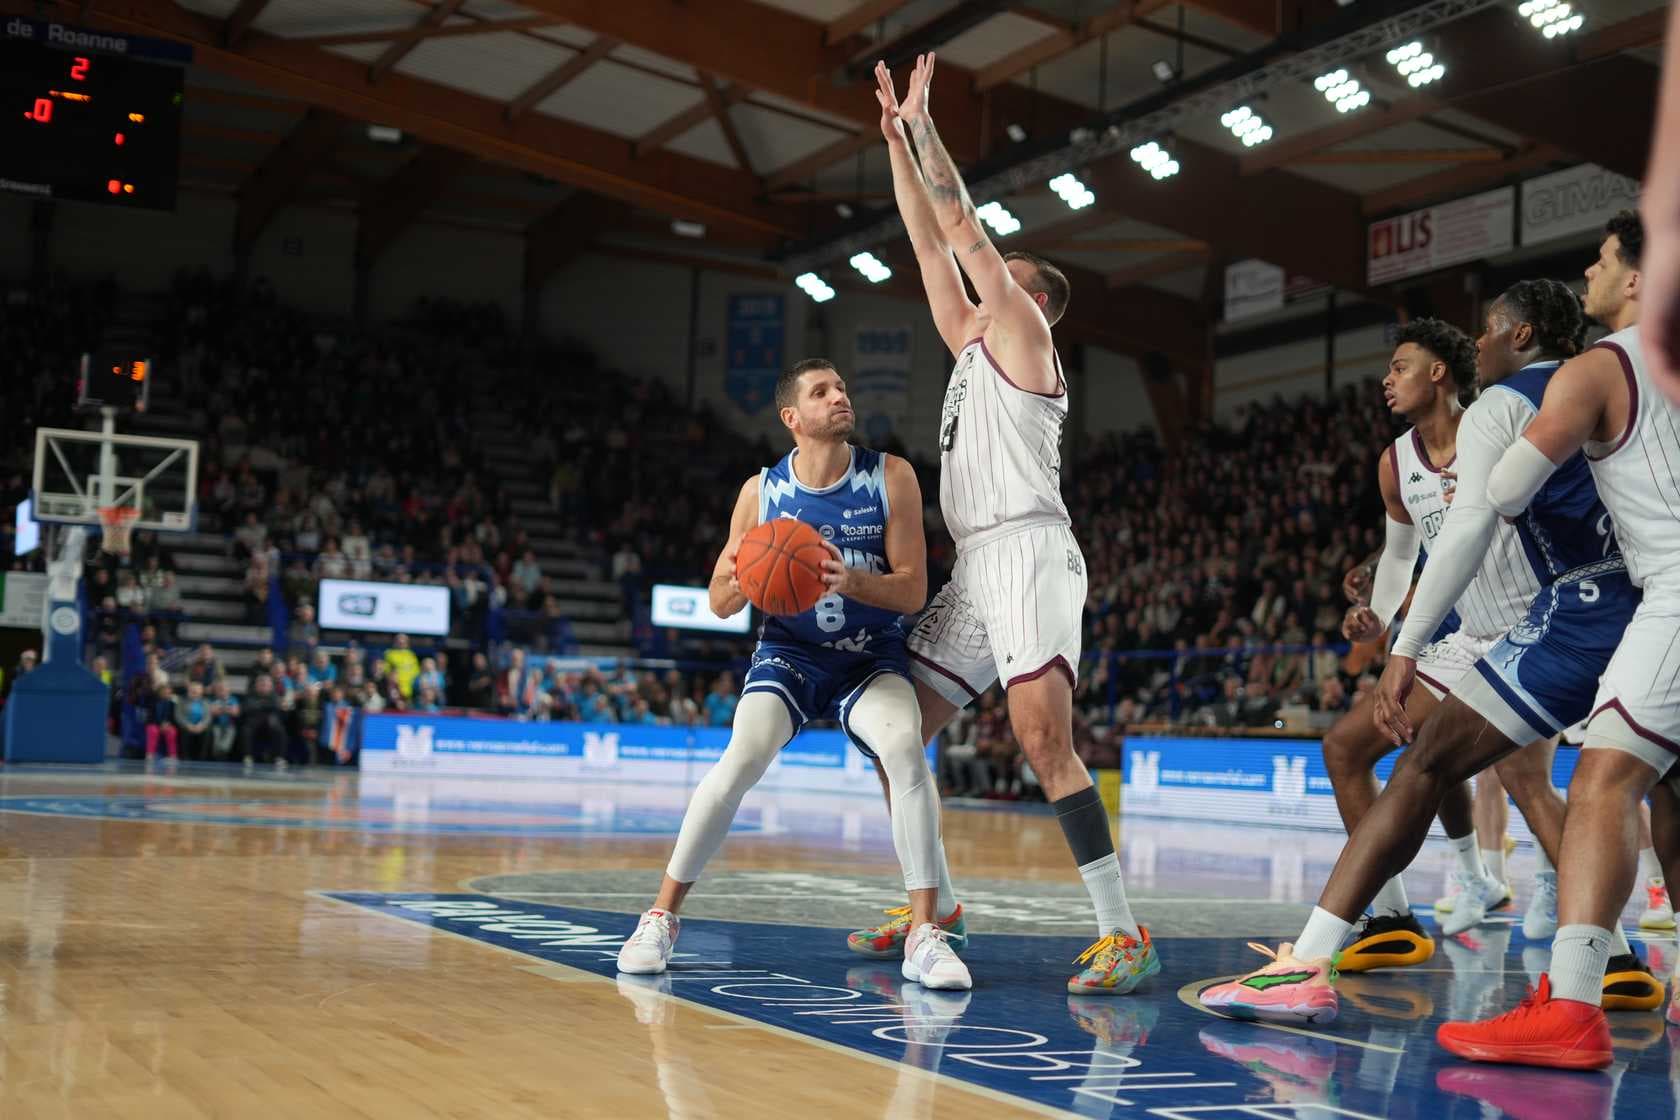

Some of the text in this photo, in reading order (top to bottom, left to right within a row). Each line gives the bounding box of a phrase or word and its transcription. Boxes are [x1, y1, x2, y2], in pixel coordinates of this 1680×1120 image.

[7, 18, 129, 53] de Roanne
[1578, 579, 1601, 603] 5
[815, 591, 846, 633] 8
